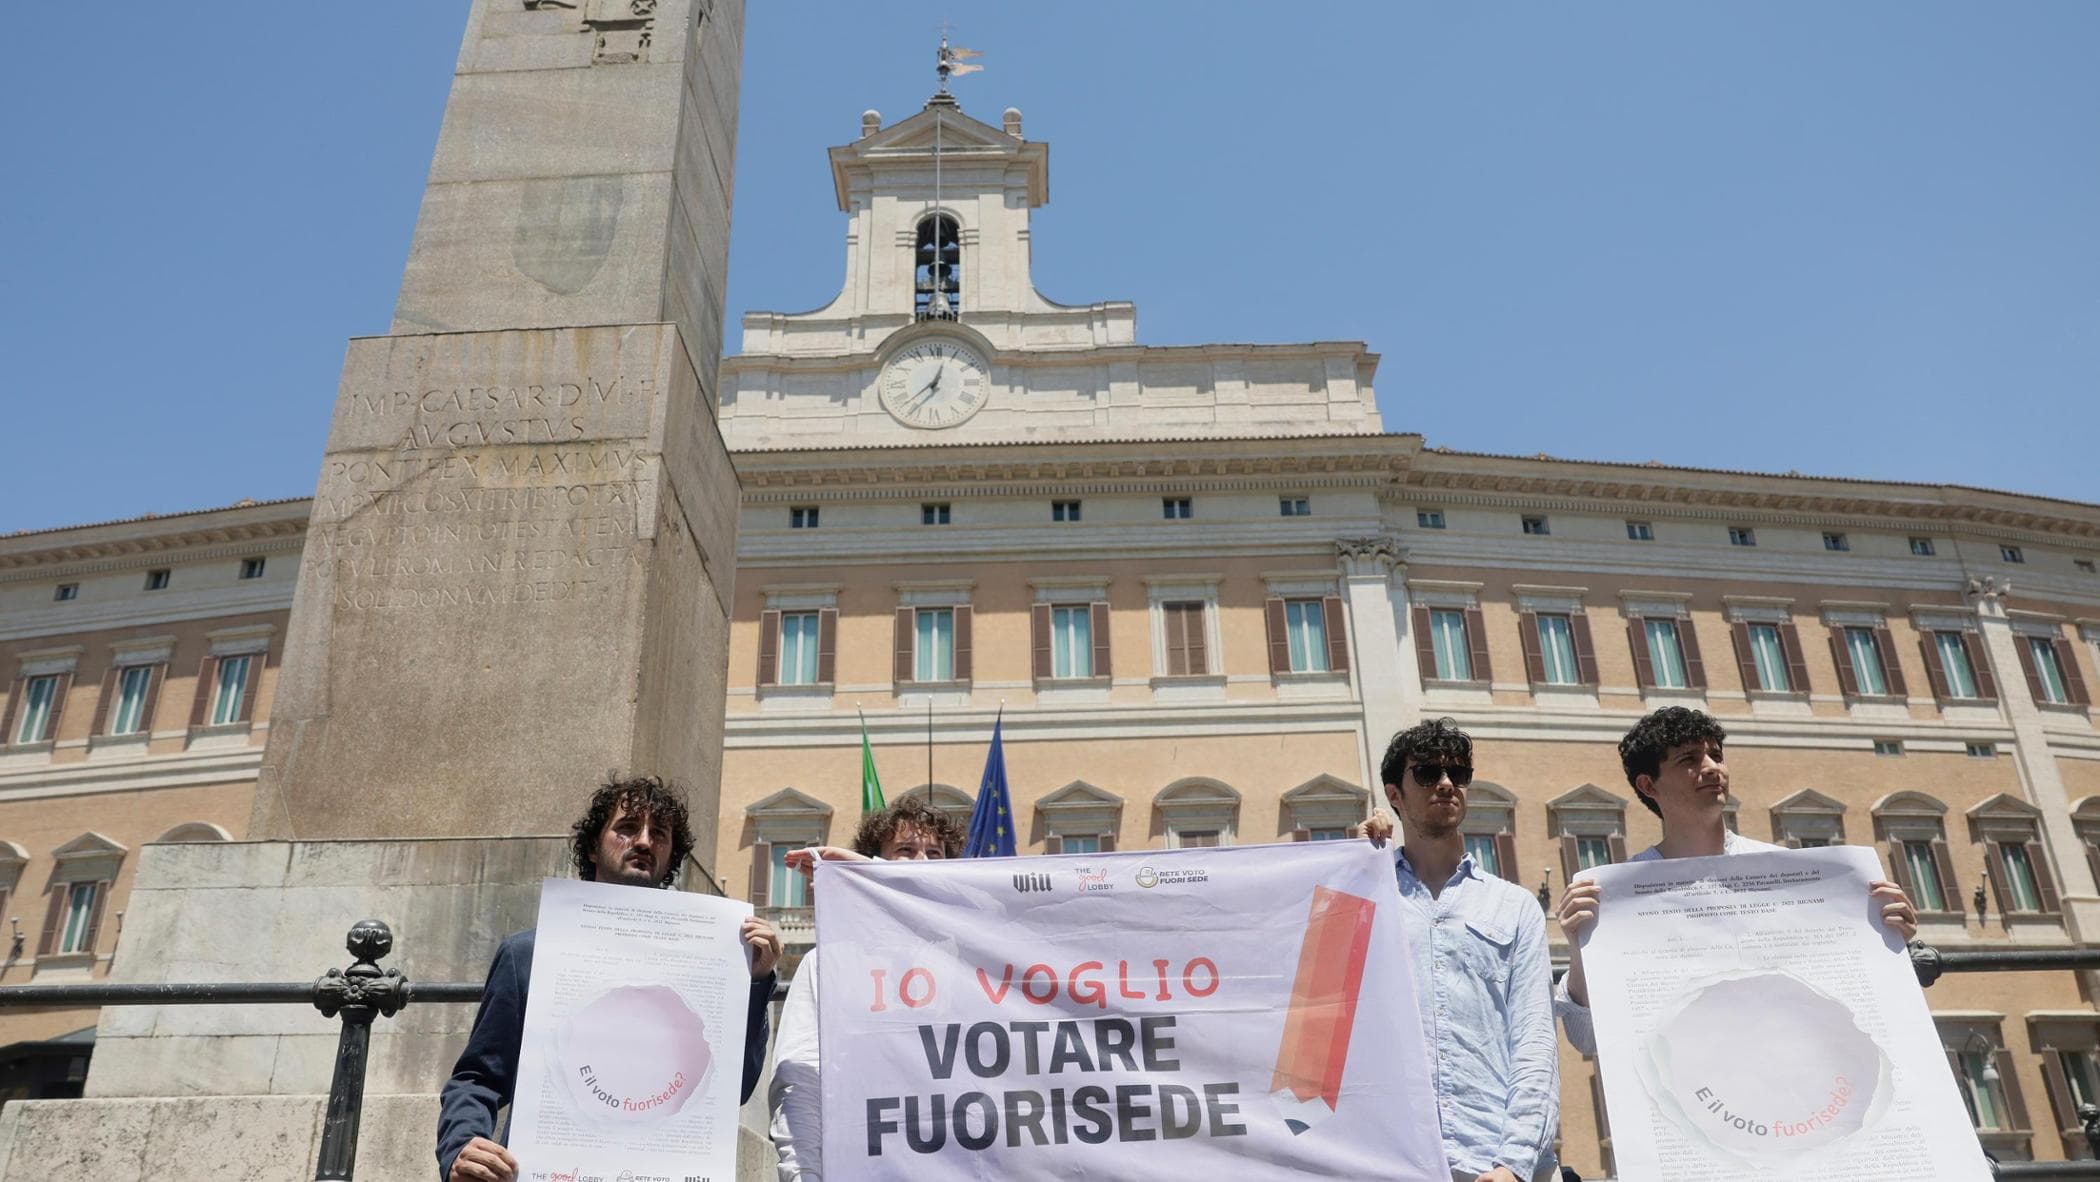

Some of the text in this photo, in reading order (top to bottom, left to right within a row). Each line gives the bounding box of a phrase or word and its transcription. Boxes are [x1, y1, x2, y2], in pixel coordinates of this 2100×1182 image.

[1087, 883, 1114, 891] LOBBY
[869, 956, 1221, 1012] IO VOGLIO
[918, 1016, 1181, 1080] VOTARE
[578, 1064, 592, 1078] E
[593, 1081, 620, 1109] voto
[622, 1071, 687, 1112] fuorisede?
[1695, 1086, 1714, 1102] E
[1707, 1099, 1725, 1114] il
[1723, 1110, 1768, 1136] voto
[1772, 1075, 1857, 1138] fuorisede?
[866, 1082, 1248, 1157] FUORISEDE
